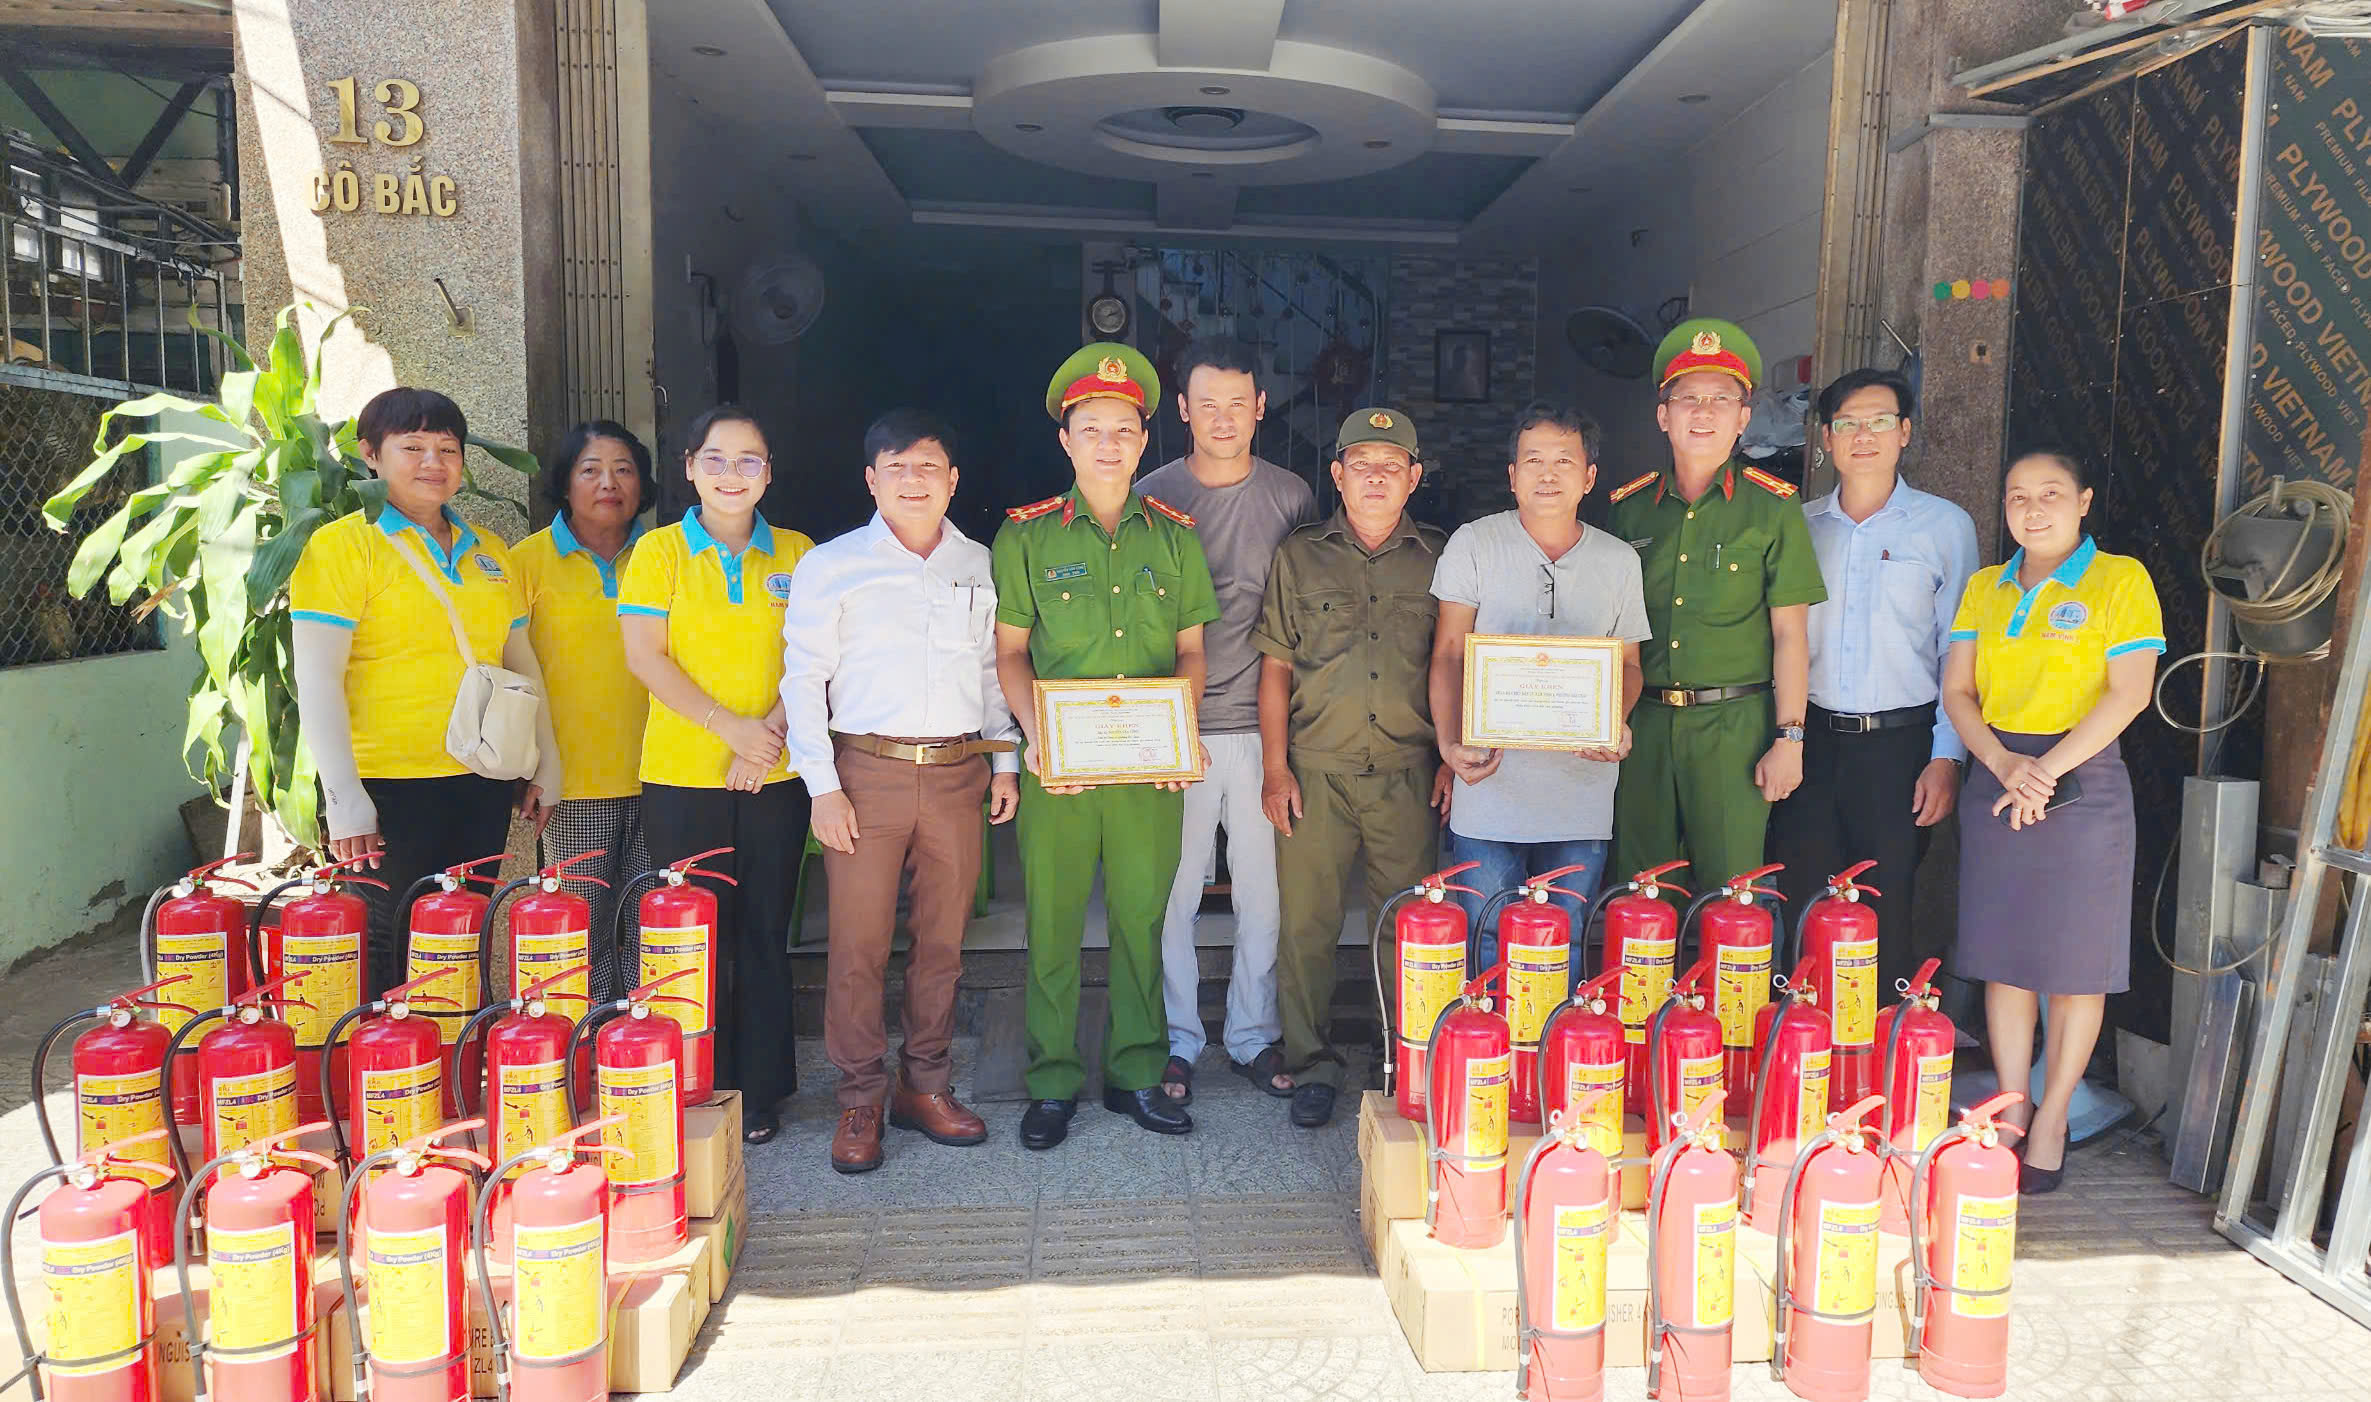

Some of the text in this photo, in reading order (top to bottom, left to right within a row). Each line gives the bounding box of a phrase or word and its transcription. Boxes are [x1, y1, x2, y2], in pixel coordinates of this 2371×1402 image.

[328, 76, 424, 147] 13
[308, 156, 457, 217] CÔ BẮC
[175, 954, 185, 962] Dry
[186, 951, 208, 960] Powder
[118, 1094, 130, 1103] Dry
